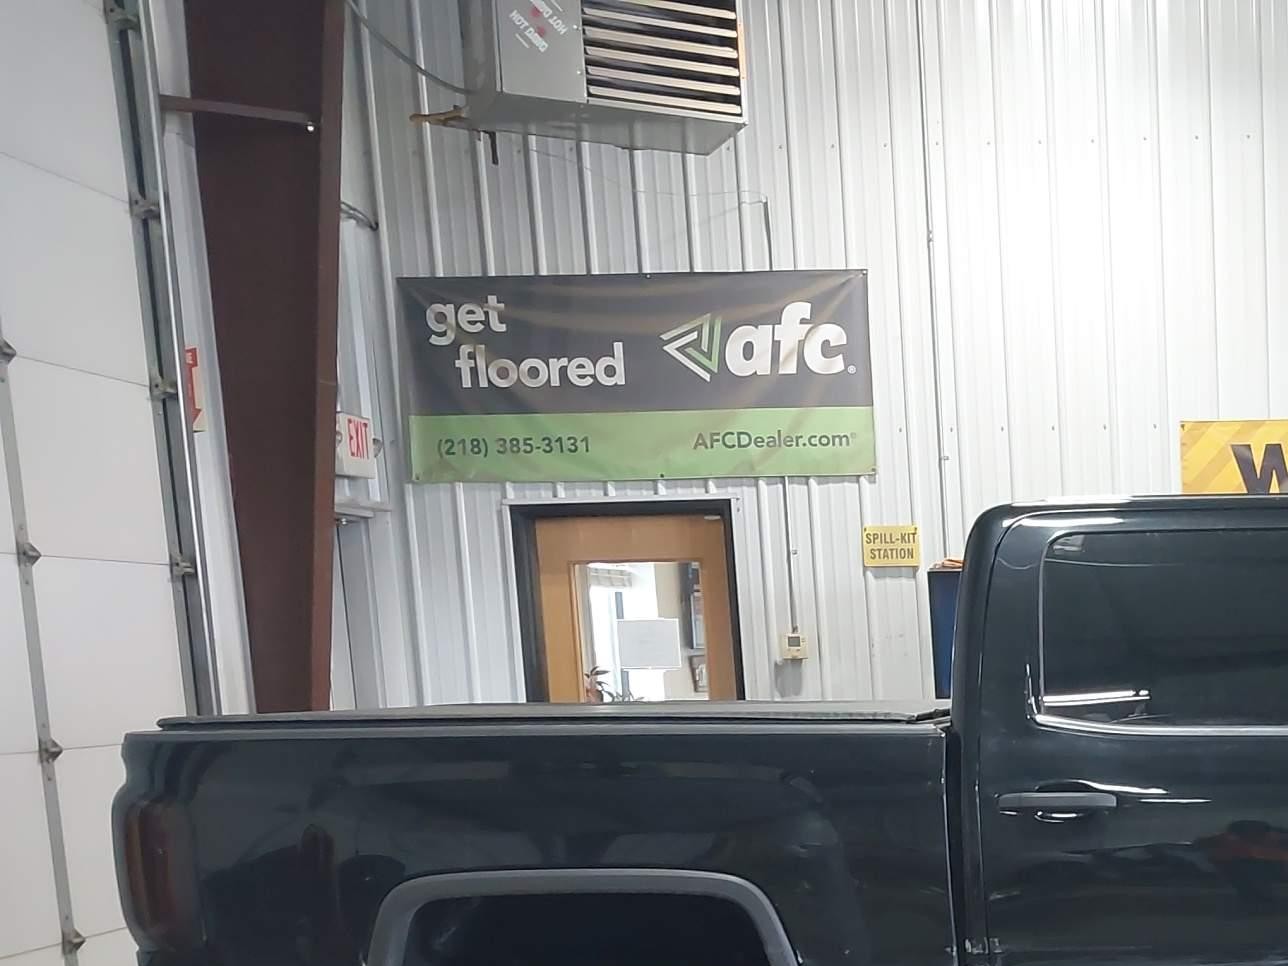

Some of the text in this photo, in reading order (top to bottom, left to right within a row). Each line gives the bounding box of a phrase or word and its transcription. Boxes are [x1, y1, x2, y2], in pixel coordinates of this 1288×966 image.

[425, 295, 507, 346] get
[454, 341, 626, 389] floored
[347, 418, 369, 460] EXIT
[437, 434, 591, 458] (218) 385-3131
[865, 532, 917, 544] SPILL-KIT
[870, 547, 914, 560] STATION
